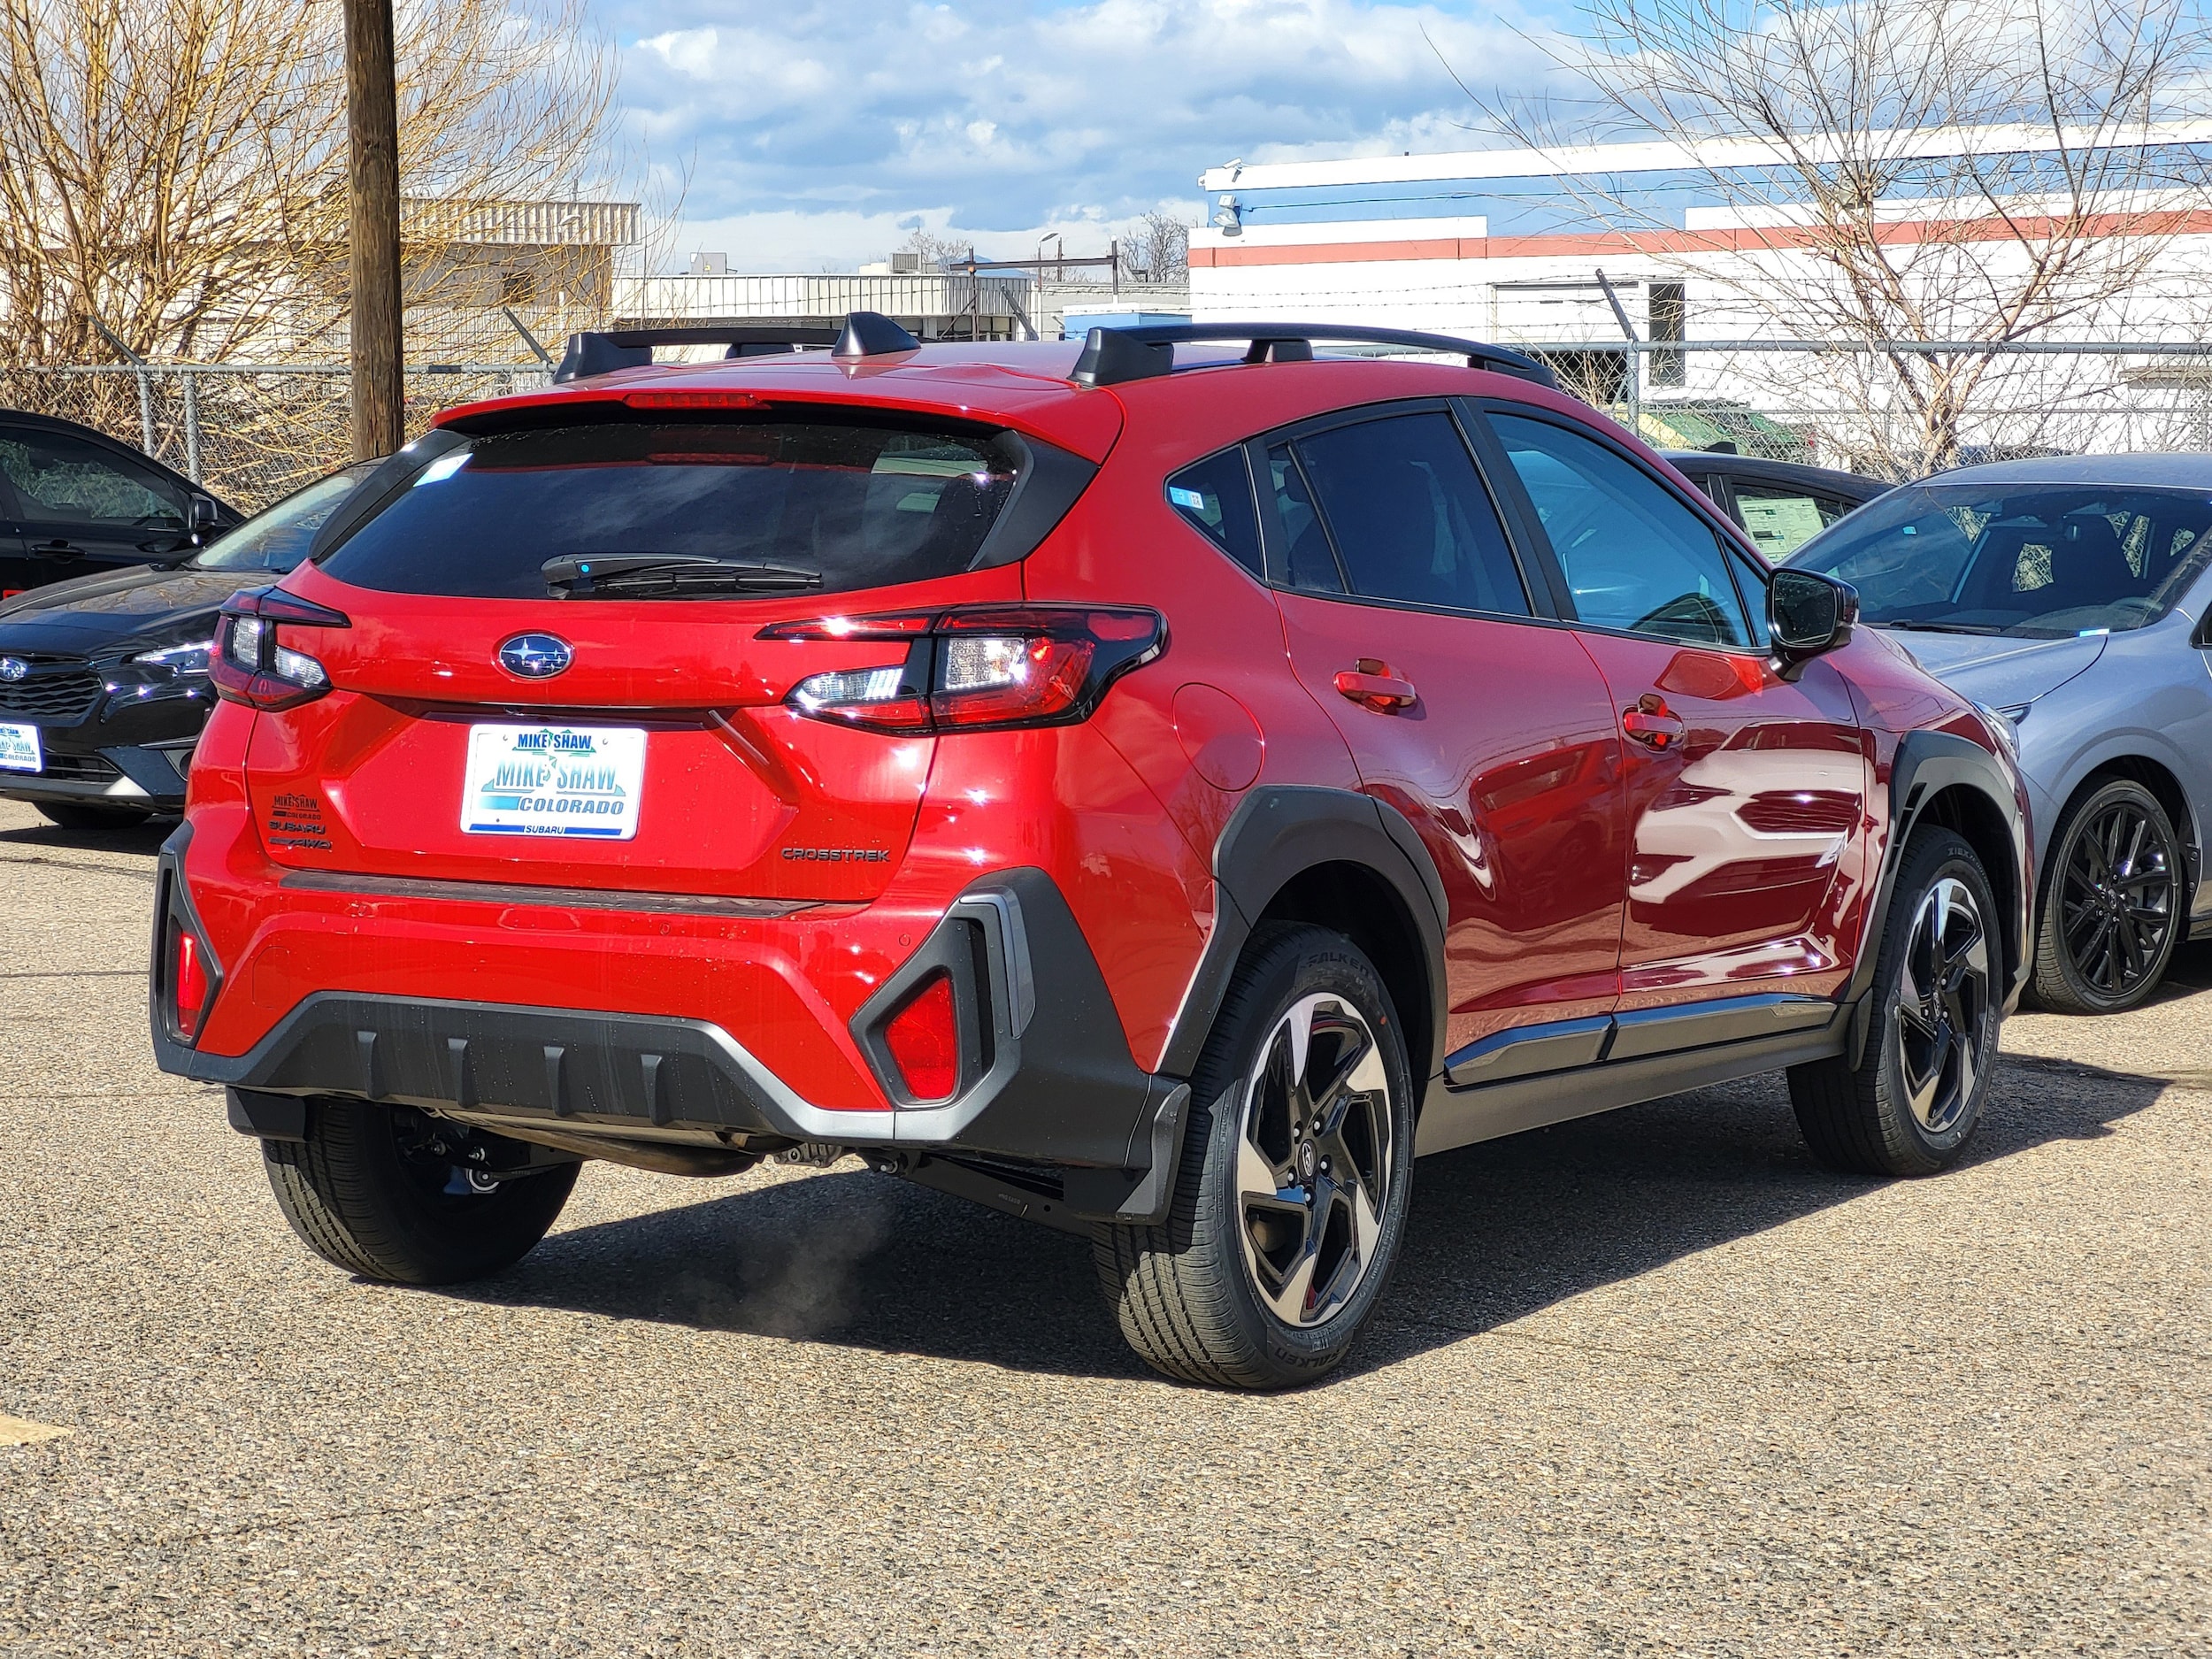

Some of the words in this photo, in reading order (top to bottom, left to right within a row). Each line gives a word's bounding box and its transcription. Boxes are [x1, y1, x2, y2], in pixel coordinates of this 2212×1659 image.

[518, 733, 547, 748] MIKE
[554, 734, 592, 749] SHAW
[4, 754, 36, 763] COLORADO
[495, 759, 545, 787] MIKE
[557, 763, 617, 790] SHAW
[274, 795, 292, 806] MIKE
[295, 796, 318, 809] SHAW
[519, 796, 624, 815] COLORADO
[286, 810, 321, 820] COLORADO
[269, 820, 326, 834] SUBARU
[526, 826, 564, 834] SUBARU
[781, 848, 891, 862] CROSSTREK
[1947, 847, 1969, 858] ZIEX
[1306, 952, 1368, 977] FALKEN
[1274, 1347, 1340, 1369] FALKEN
